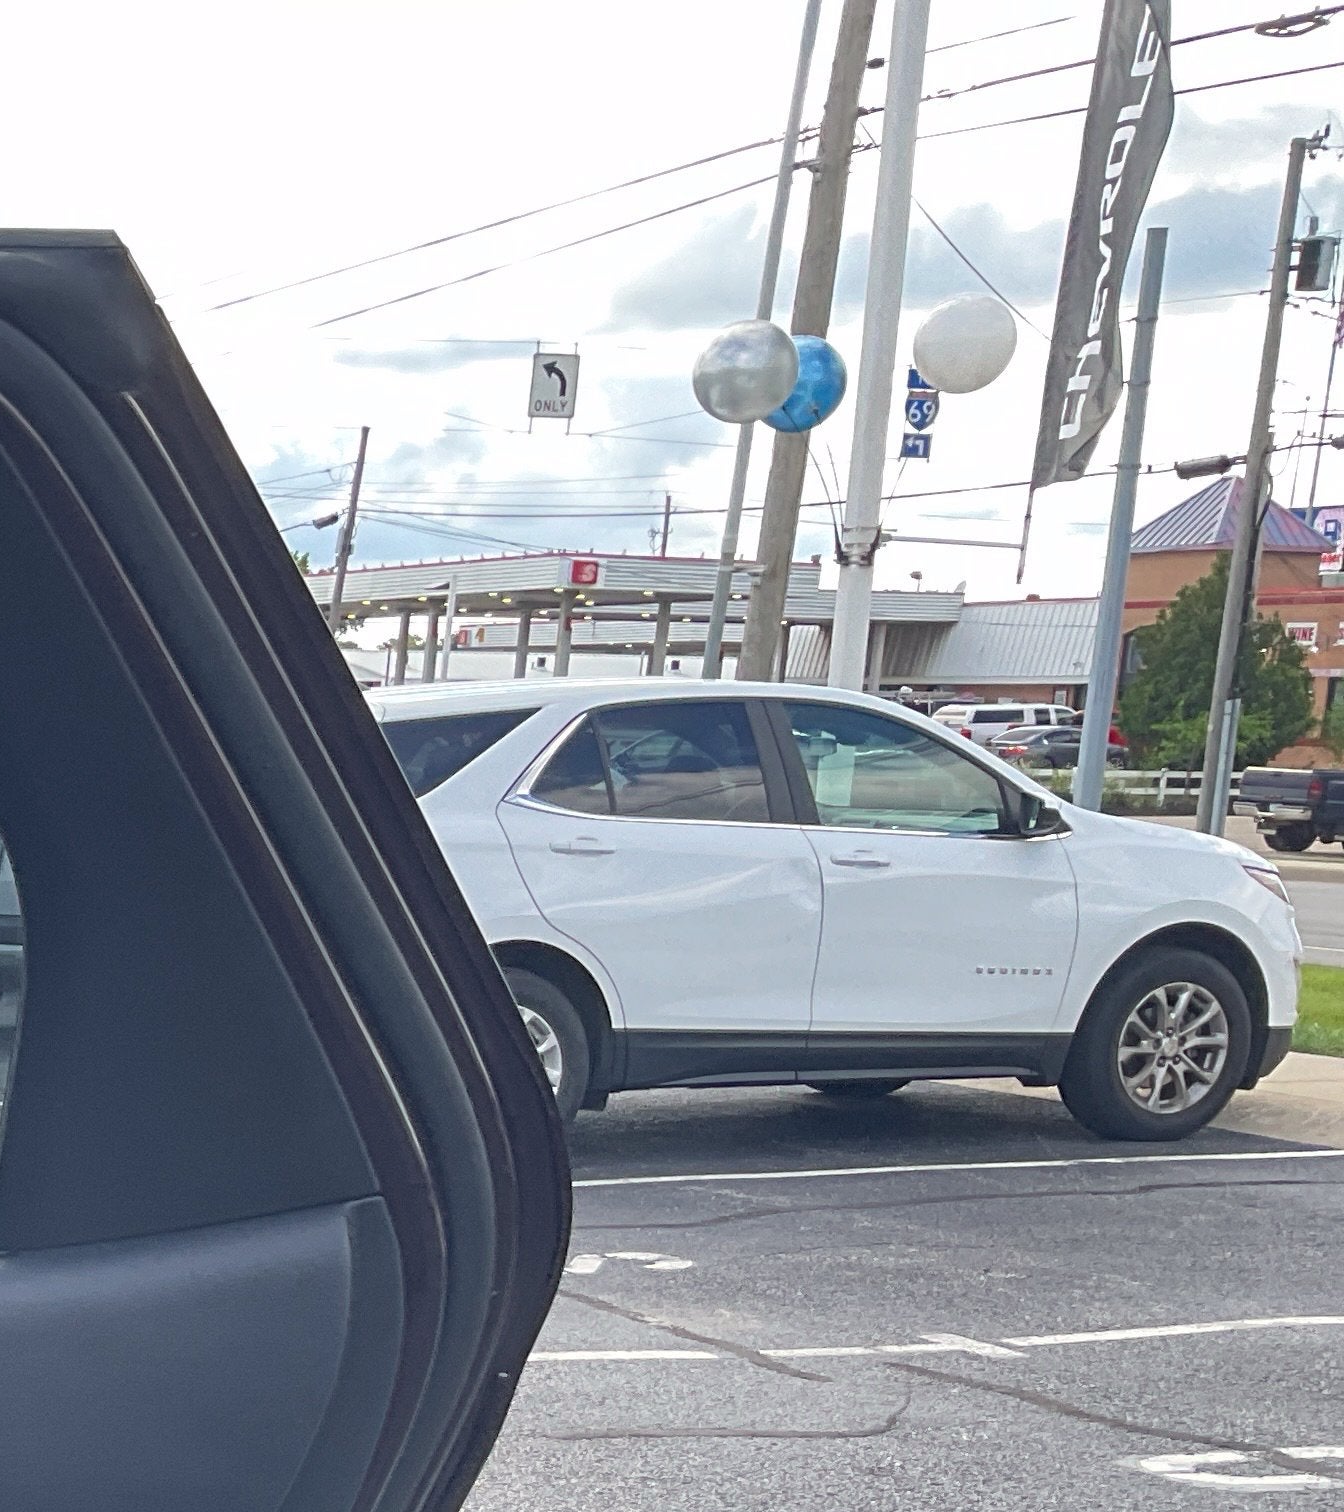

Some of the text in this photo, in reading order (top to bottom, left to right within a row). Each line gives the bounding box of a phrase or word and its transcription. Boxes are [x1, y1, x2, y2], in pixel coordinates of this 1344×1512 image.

[1058, 3, 1161, 440] CHEVROLE
[534, 399, 568, 412] ONLY
[908, 401, 936, 423] 69
